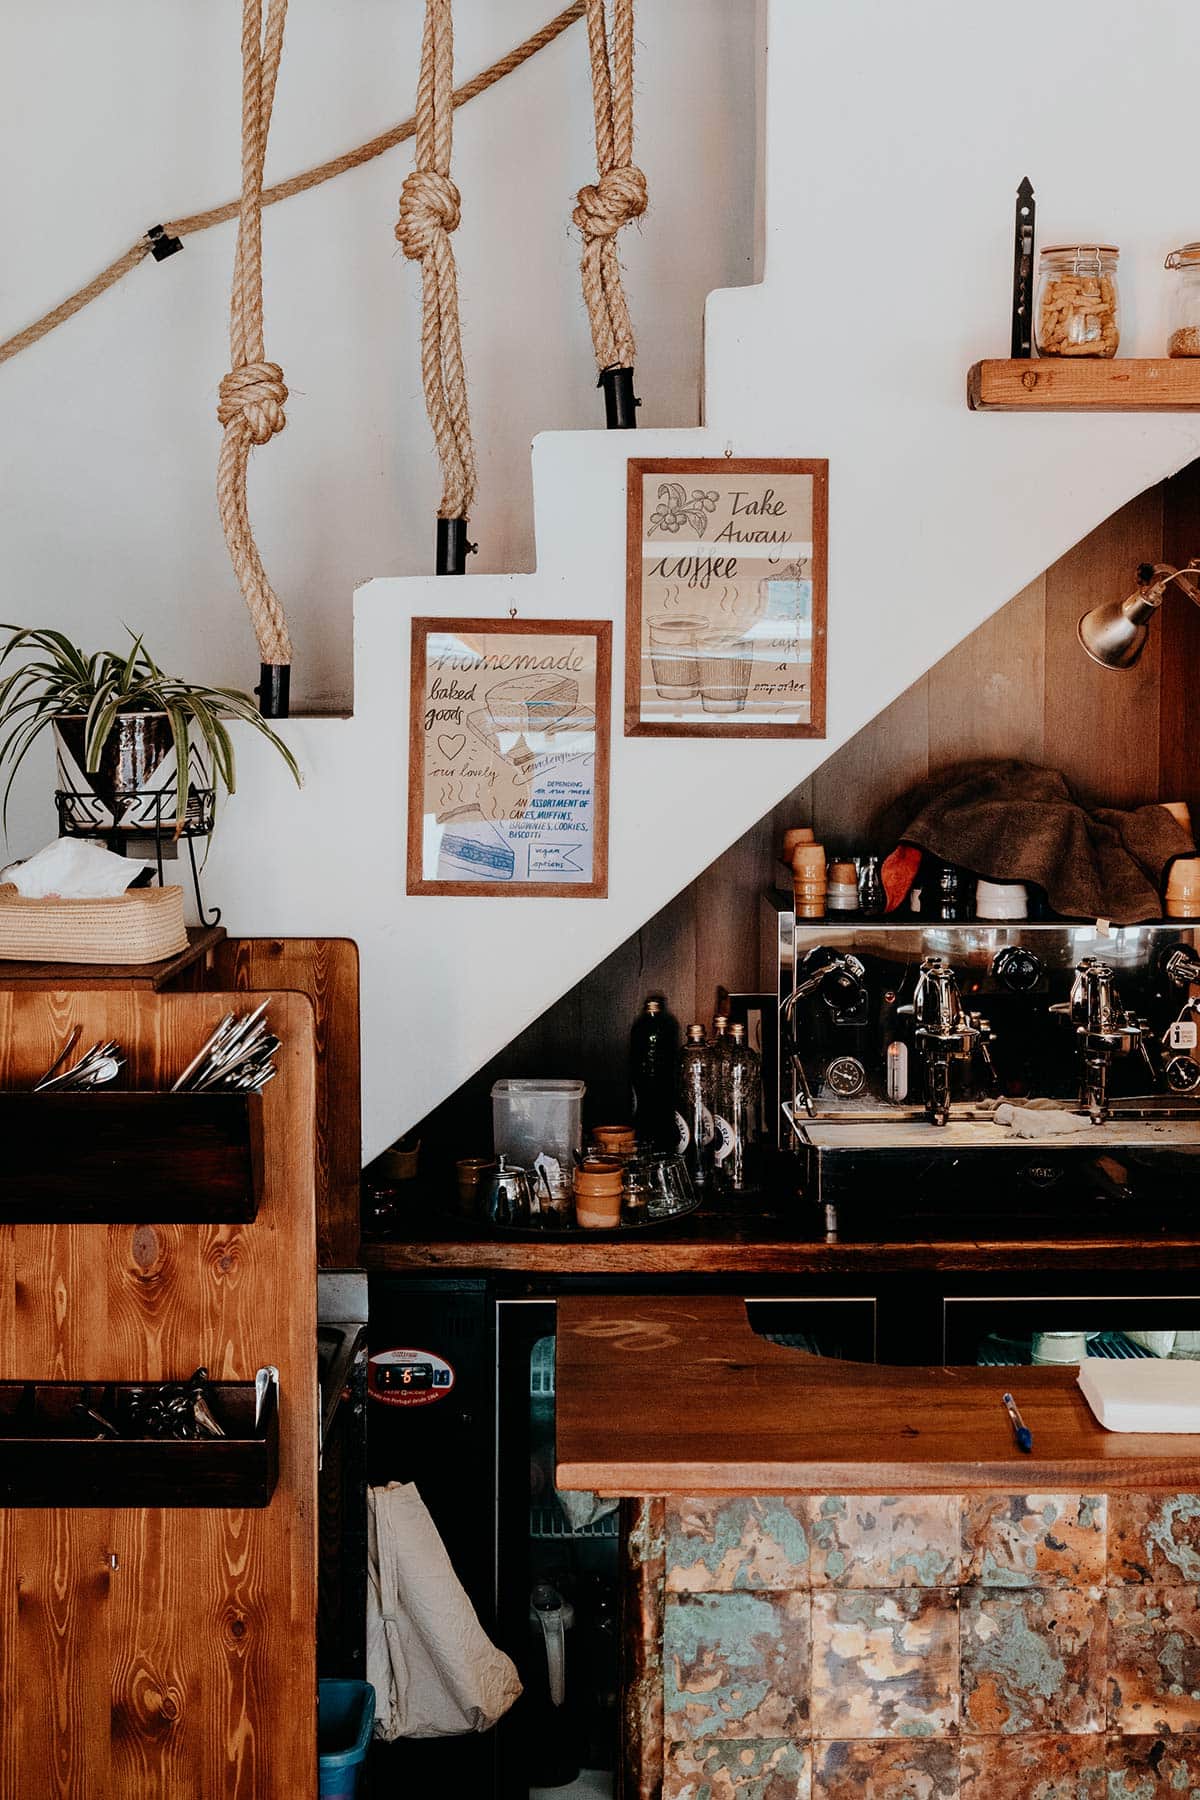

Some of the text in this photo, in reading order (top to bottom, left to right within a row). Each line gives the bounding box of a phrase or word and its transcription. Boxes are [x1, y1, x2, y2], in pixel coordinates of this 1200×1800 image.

[727, 488, 788, 516] Take
[713, 520, 793, 564] Away
[429, 648, 584, 672] homemade
[427, 677, 477, 702] baked
[424, 706, 464, 731] goods
[428, 764, 500, 786] our lovely
[514, 798, 590, 808] AN ASSORTMENT OF
[533, 861, 564, 869] options
[535, 848, 560, 858] vegan
